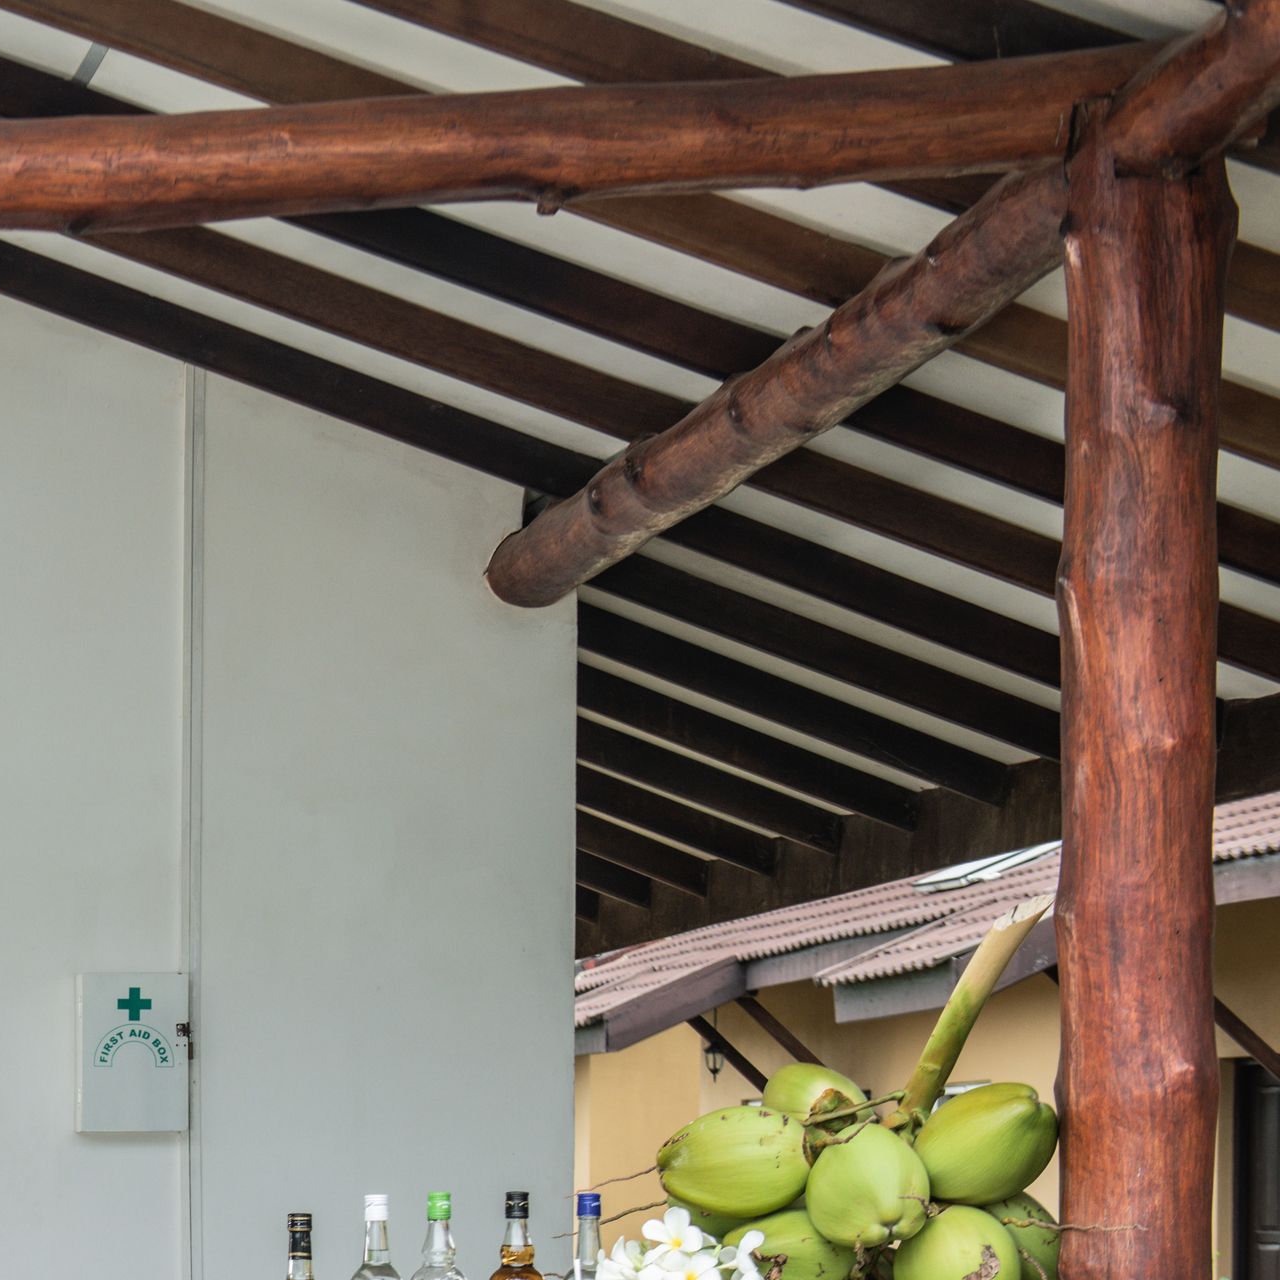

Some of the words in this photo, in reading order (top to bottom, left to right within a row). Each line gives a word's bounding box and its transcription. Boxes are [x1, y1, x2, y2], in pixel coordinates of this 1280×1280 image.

[99, 1031, 125, 1063] FIRST
[129, 1029, 151, 1040] AID
[151, 1038, 169, 1064] BOX
